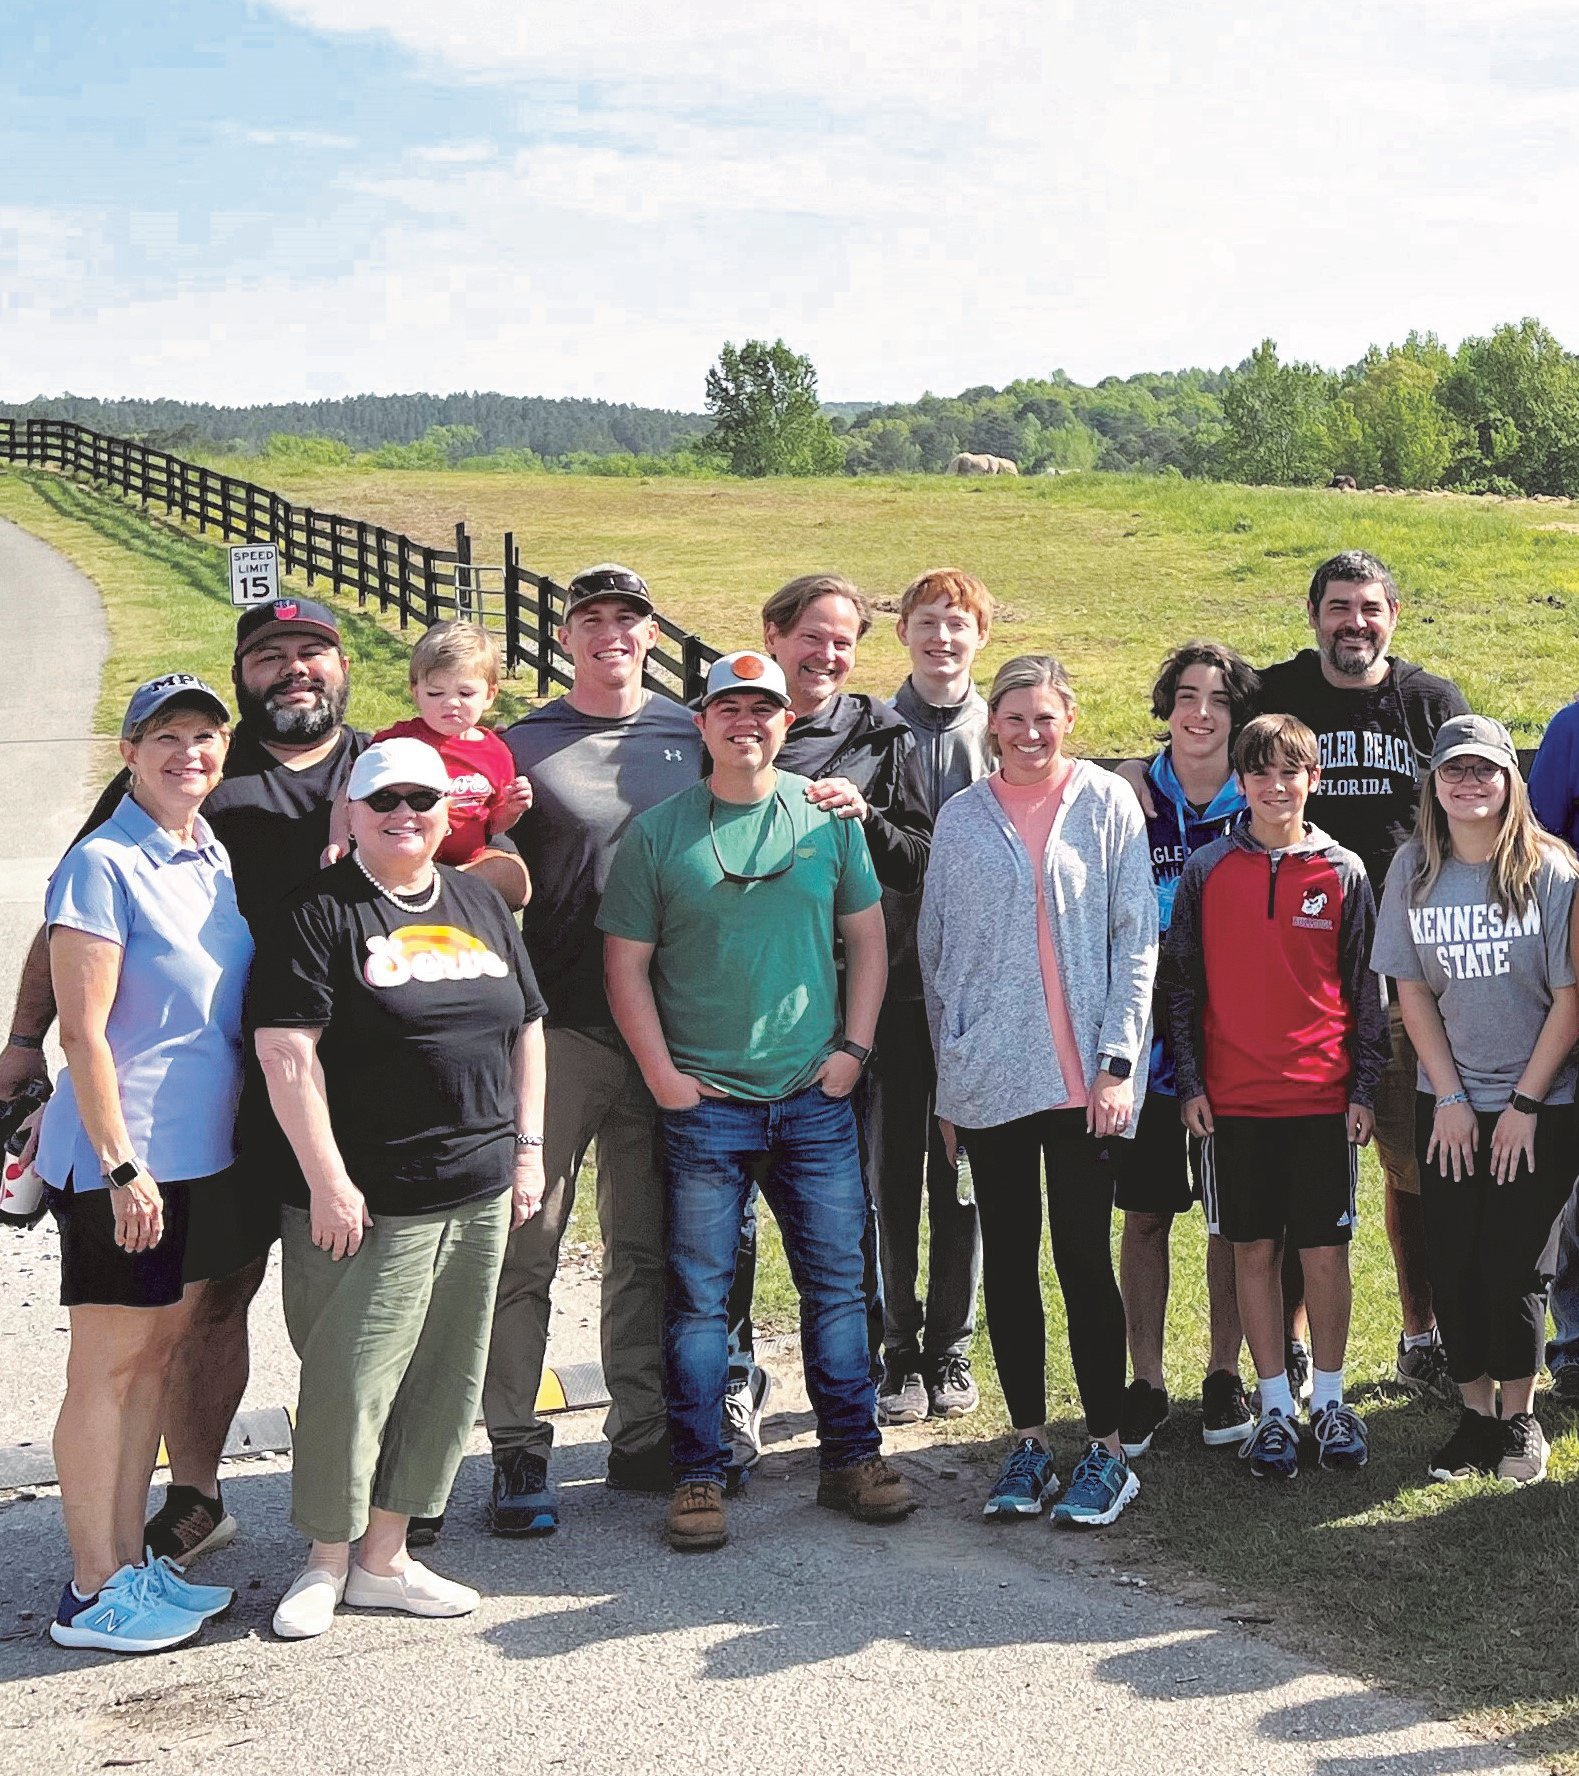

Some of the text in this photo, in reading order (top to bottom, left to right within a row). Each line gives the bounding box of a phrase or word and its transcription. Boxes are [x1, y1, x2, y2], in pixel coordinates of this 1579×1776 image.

[233, 551, 274, 561] SPEED
[238, 564, 269, 573] LIMIT
[240, 576, 270, 599] 15
[1317, 730, 1418, 782] GLER BEACH
[1316, 778, 1393, 796] FLORIDA
[1408, 899, 1541, 944] KENNESAW
[1436, 940, 1510, 980] STATE
